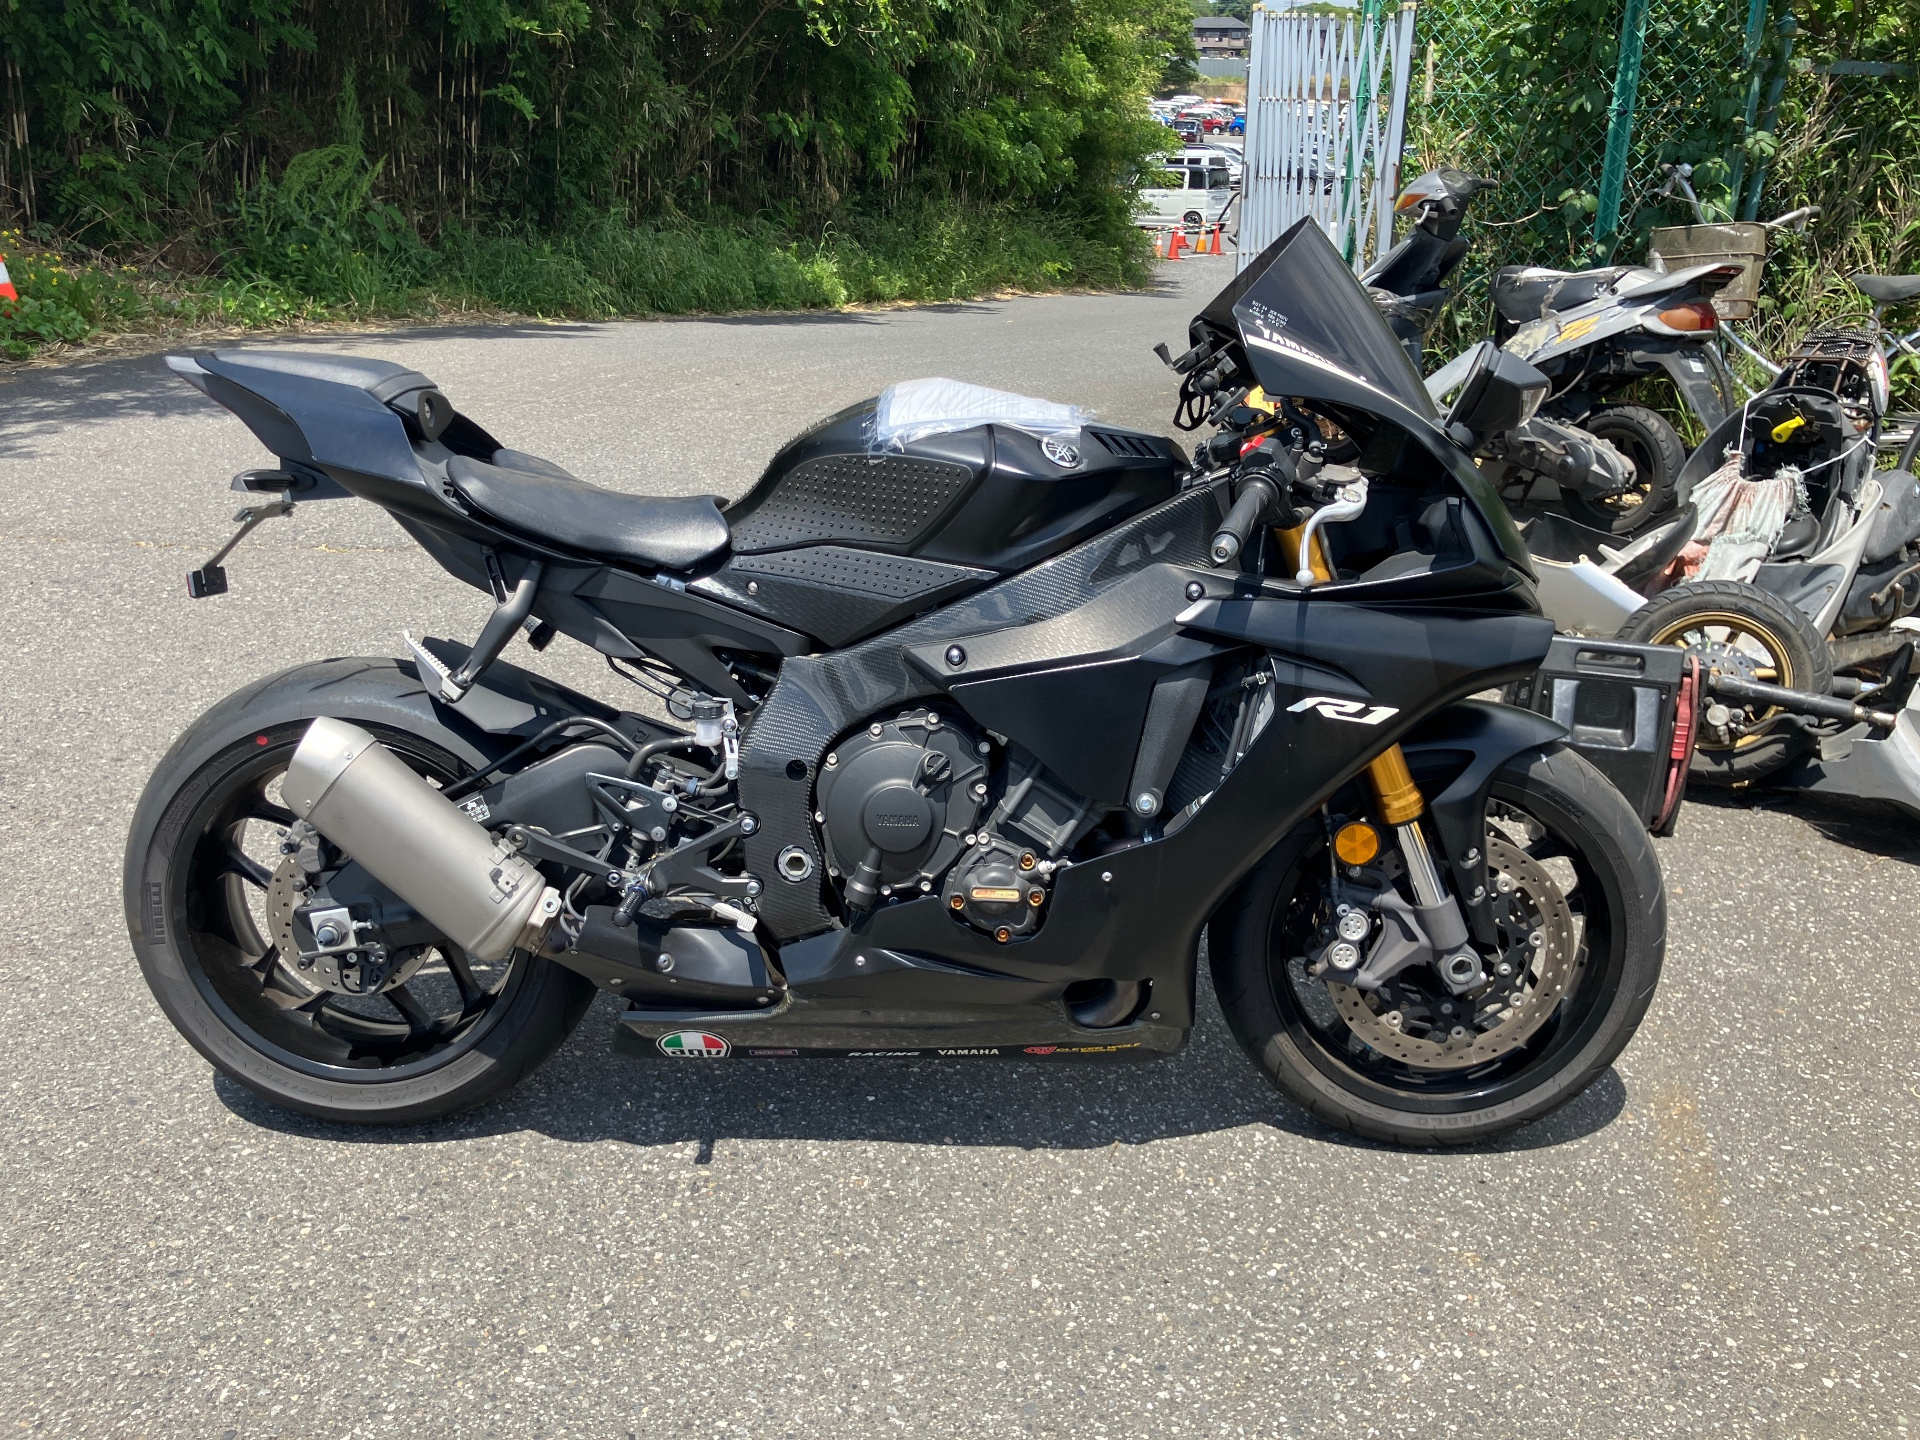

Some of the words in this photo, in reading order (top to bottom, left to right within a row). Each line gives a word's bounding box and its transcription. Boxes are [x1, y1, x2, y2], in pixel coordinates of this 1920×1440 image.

[1286, 696, 1400, 725] R1
[876, 814, 920, 827] YAMAHA
[938, 1048, 1000, 1056] YAMAHA
